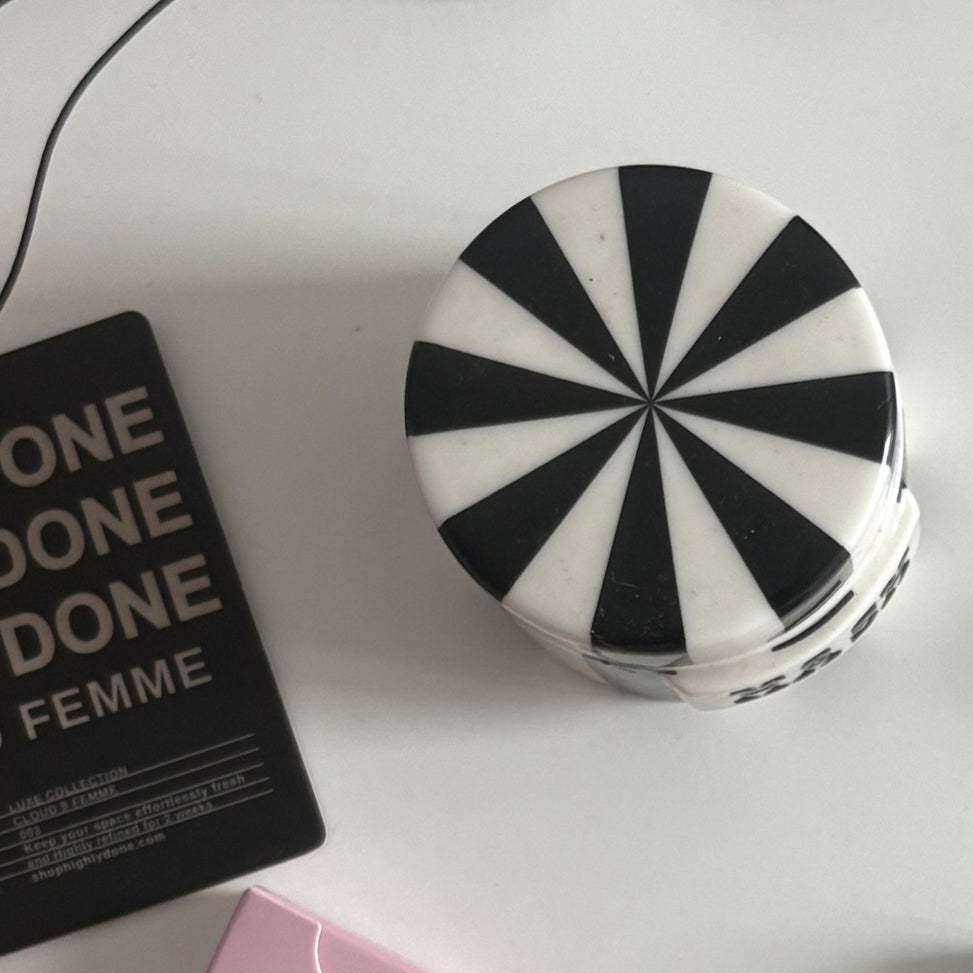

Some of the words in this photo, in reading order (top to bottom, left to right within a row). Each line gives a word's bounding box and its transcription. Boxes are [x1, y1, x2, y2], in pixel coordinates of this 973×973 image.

[0, 553, 222, 678] DONE
[18, 646, 213, 741] FEMME
[8, 793, 42, 814] LUXE
[45, 766, 129, 802] COLLECTION
[12, 803, 58, 828] CLOUD
[71, 784, 118, 808] FEMME
[23, 837, 57, 855] Keep
[60, 825, 89, 846] your
[93, 811, 131, 834] space
[135, 786, 208, 818] effortlessly
[210, 773, 246, 794] fresh
[96, 823, 140, 847] refined
[174, 801, 213, 822] weeks
[31, 831, 166, 884] shophighlydone.com
